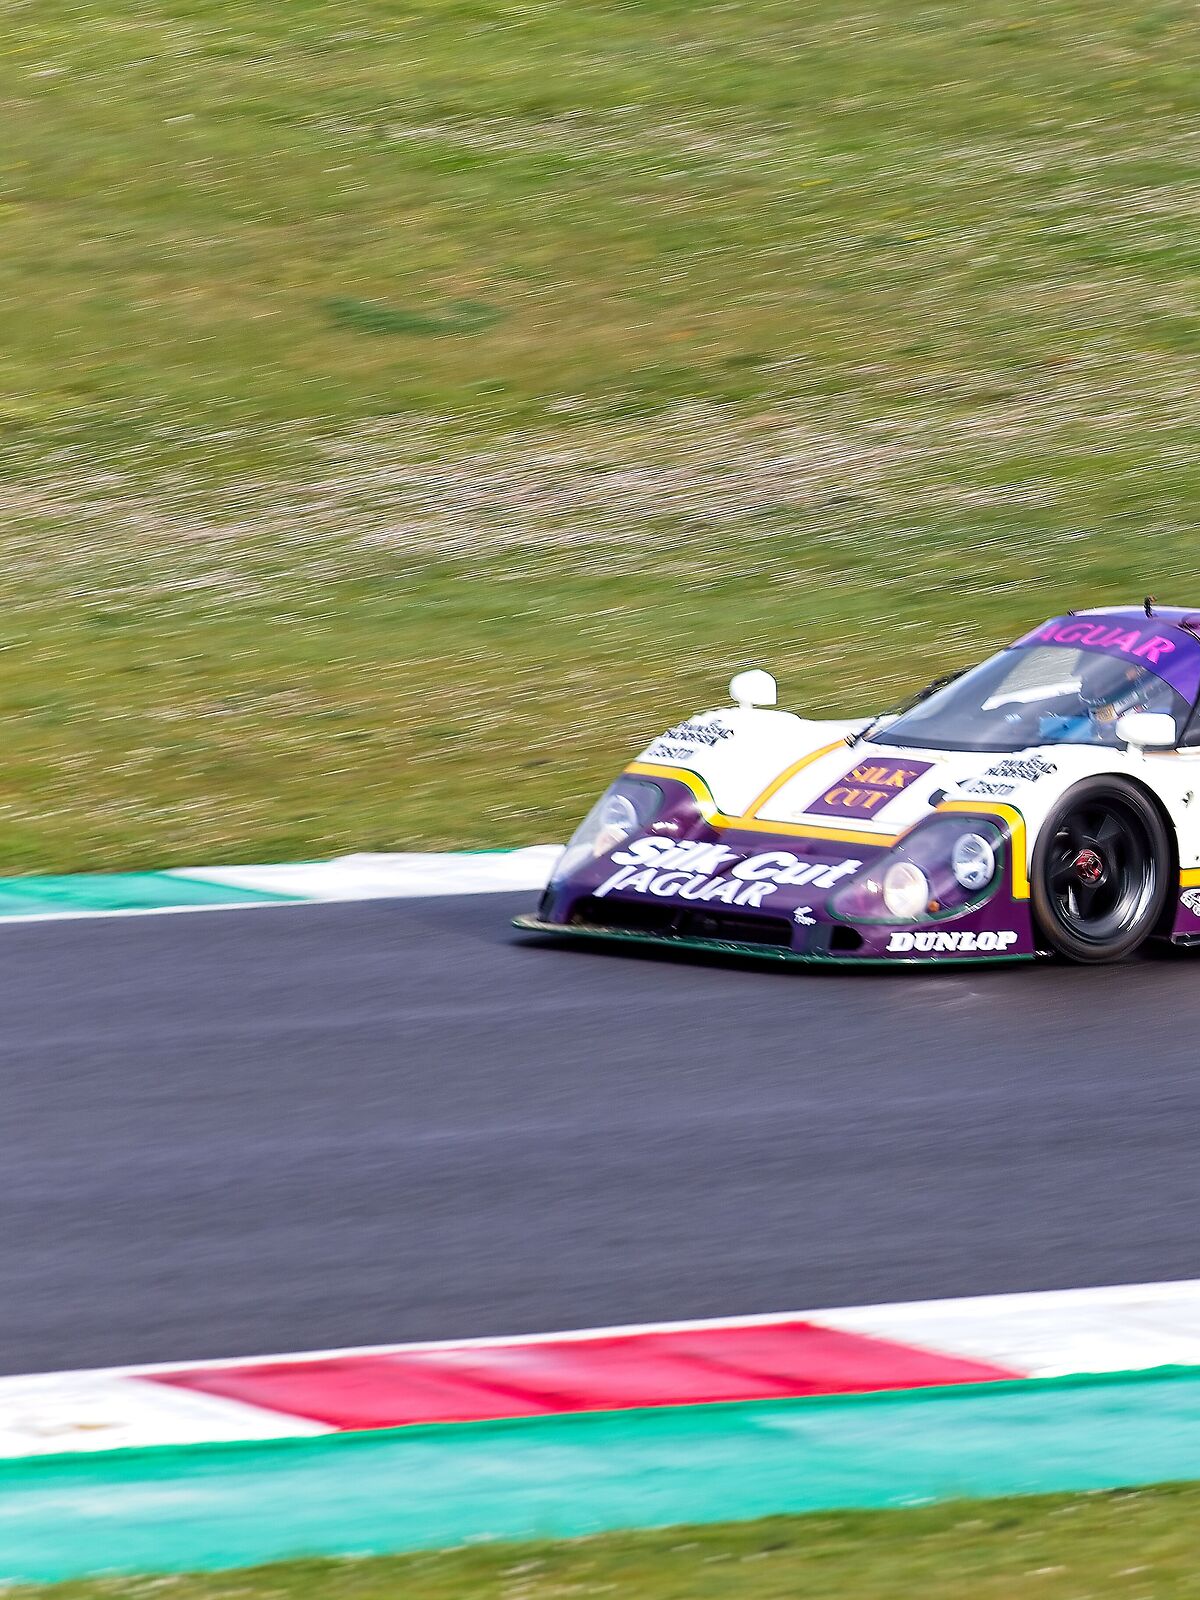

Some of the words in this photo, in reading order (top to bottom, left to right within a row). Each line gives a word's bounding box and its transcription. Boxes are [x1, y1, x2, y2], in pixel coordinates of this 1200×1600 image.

[843, 765, 919, 789] SILK
[823, 787, 889, 810] CUT
[611, 836, 740, 874] Silk
[731, 851, 864, 889] Cut
[591, 865, 778, 908] JAGUAR
[886, 930, 1018, 952] DUNLOP
